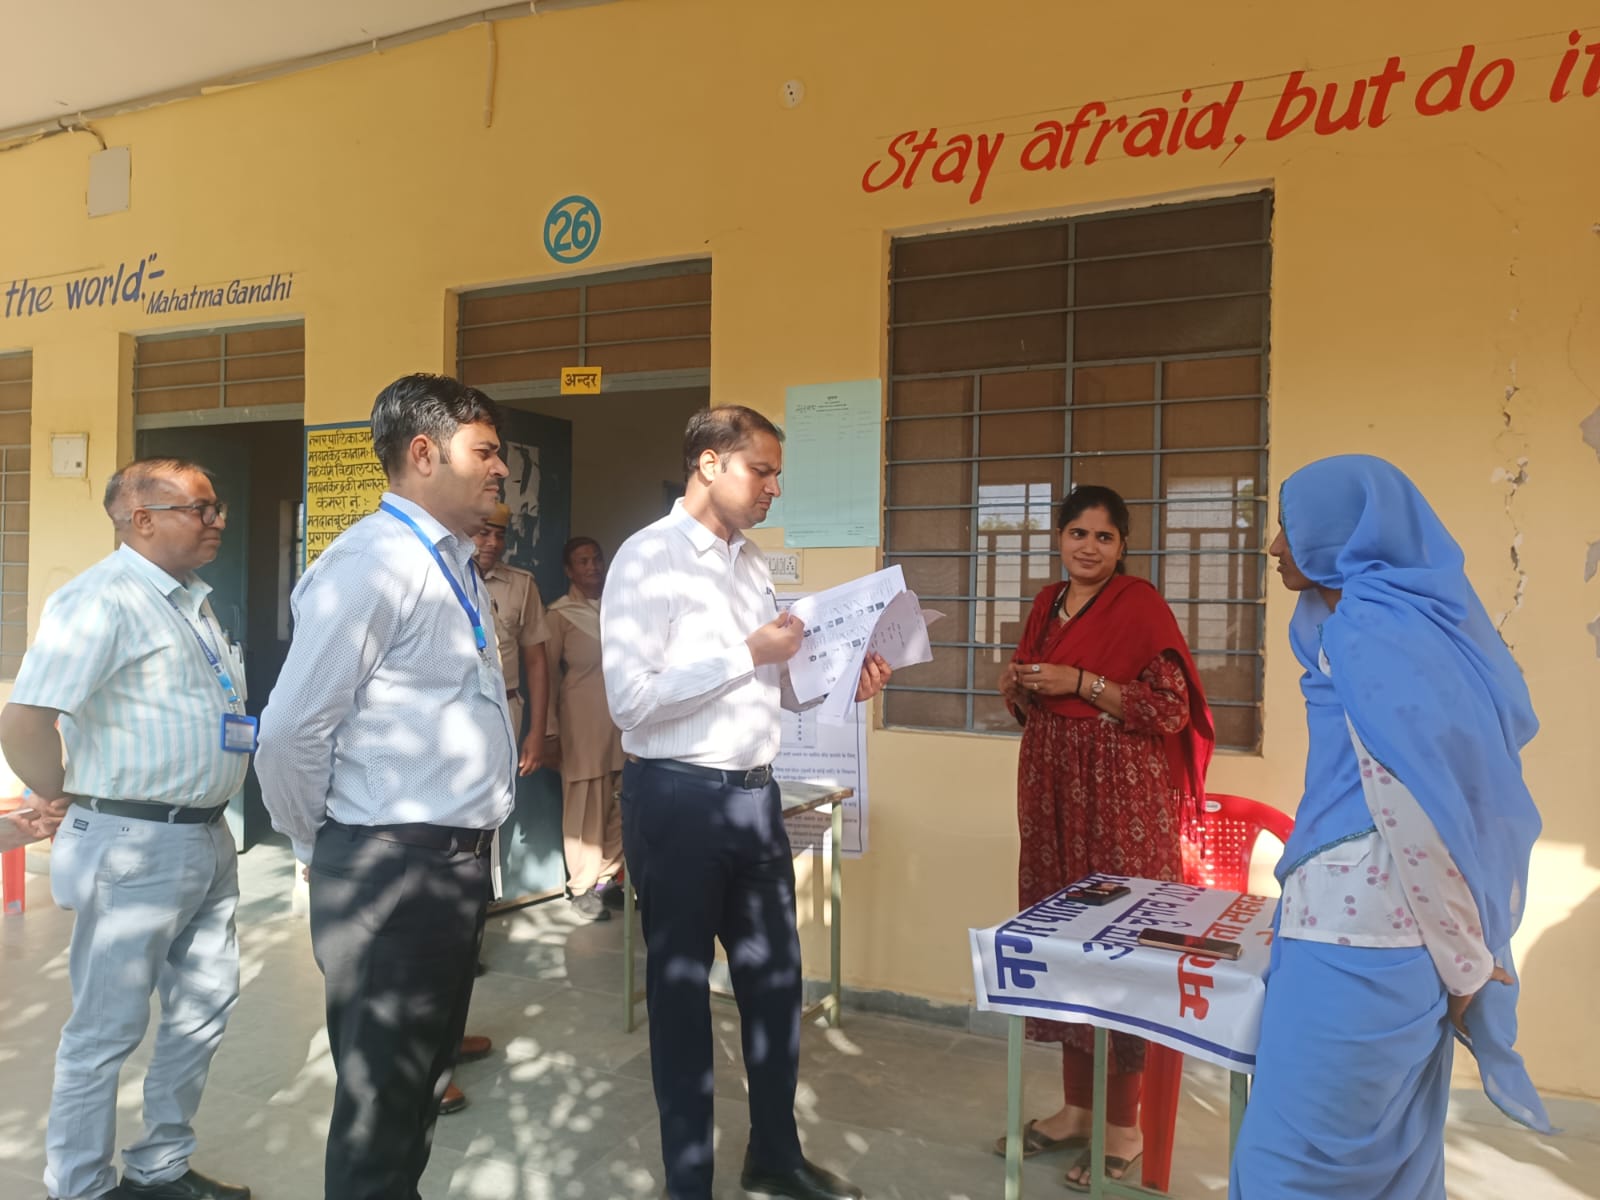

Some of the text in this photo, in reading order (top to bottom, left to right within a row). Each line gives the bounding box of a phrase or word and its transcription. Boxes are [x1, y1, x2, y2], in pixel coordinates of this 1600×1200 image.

[862, 127, 1005, 205] Stay
[1020, 80, 1247, 170] afraid,
[1266, 56, 1406, 142] but
[1415, 44, 1515, 117] do
[550, 206, 592, 251] 26
[5, 279, 54, 318] the
[146, 272, 294, 315] Mahatma Gandhi
[564, 373, 598, 388] अन्दर
[1112, 897, 1192, 929] चुनाव
[995, 920, 1058, 990] नगर
